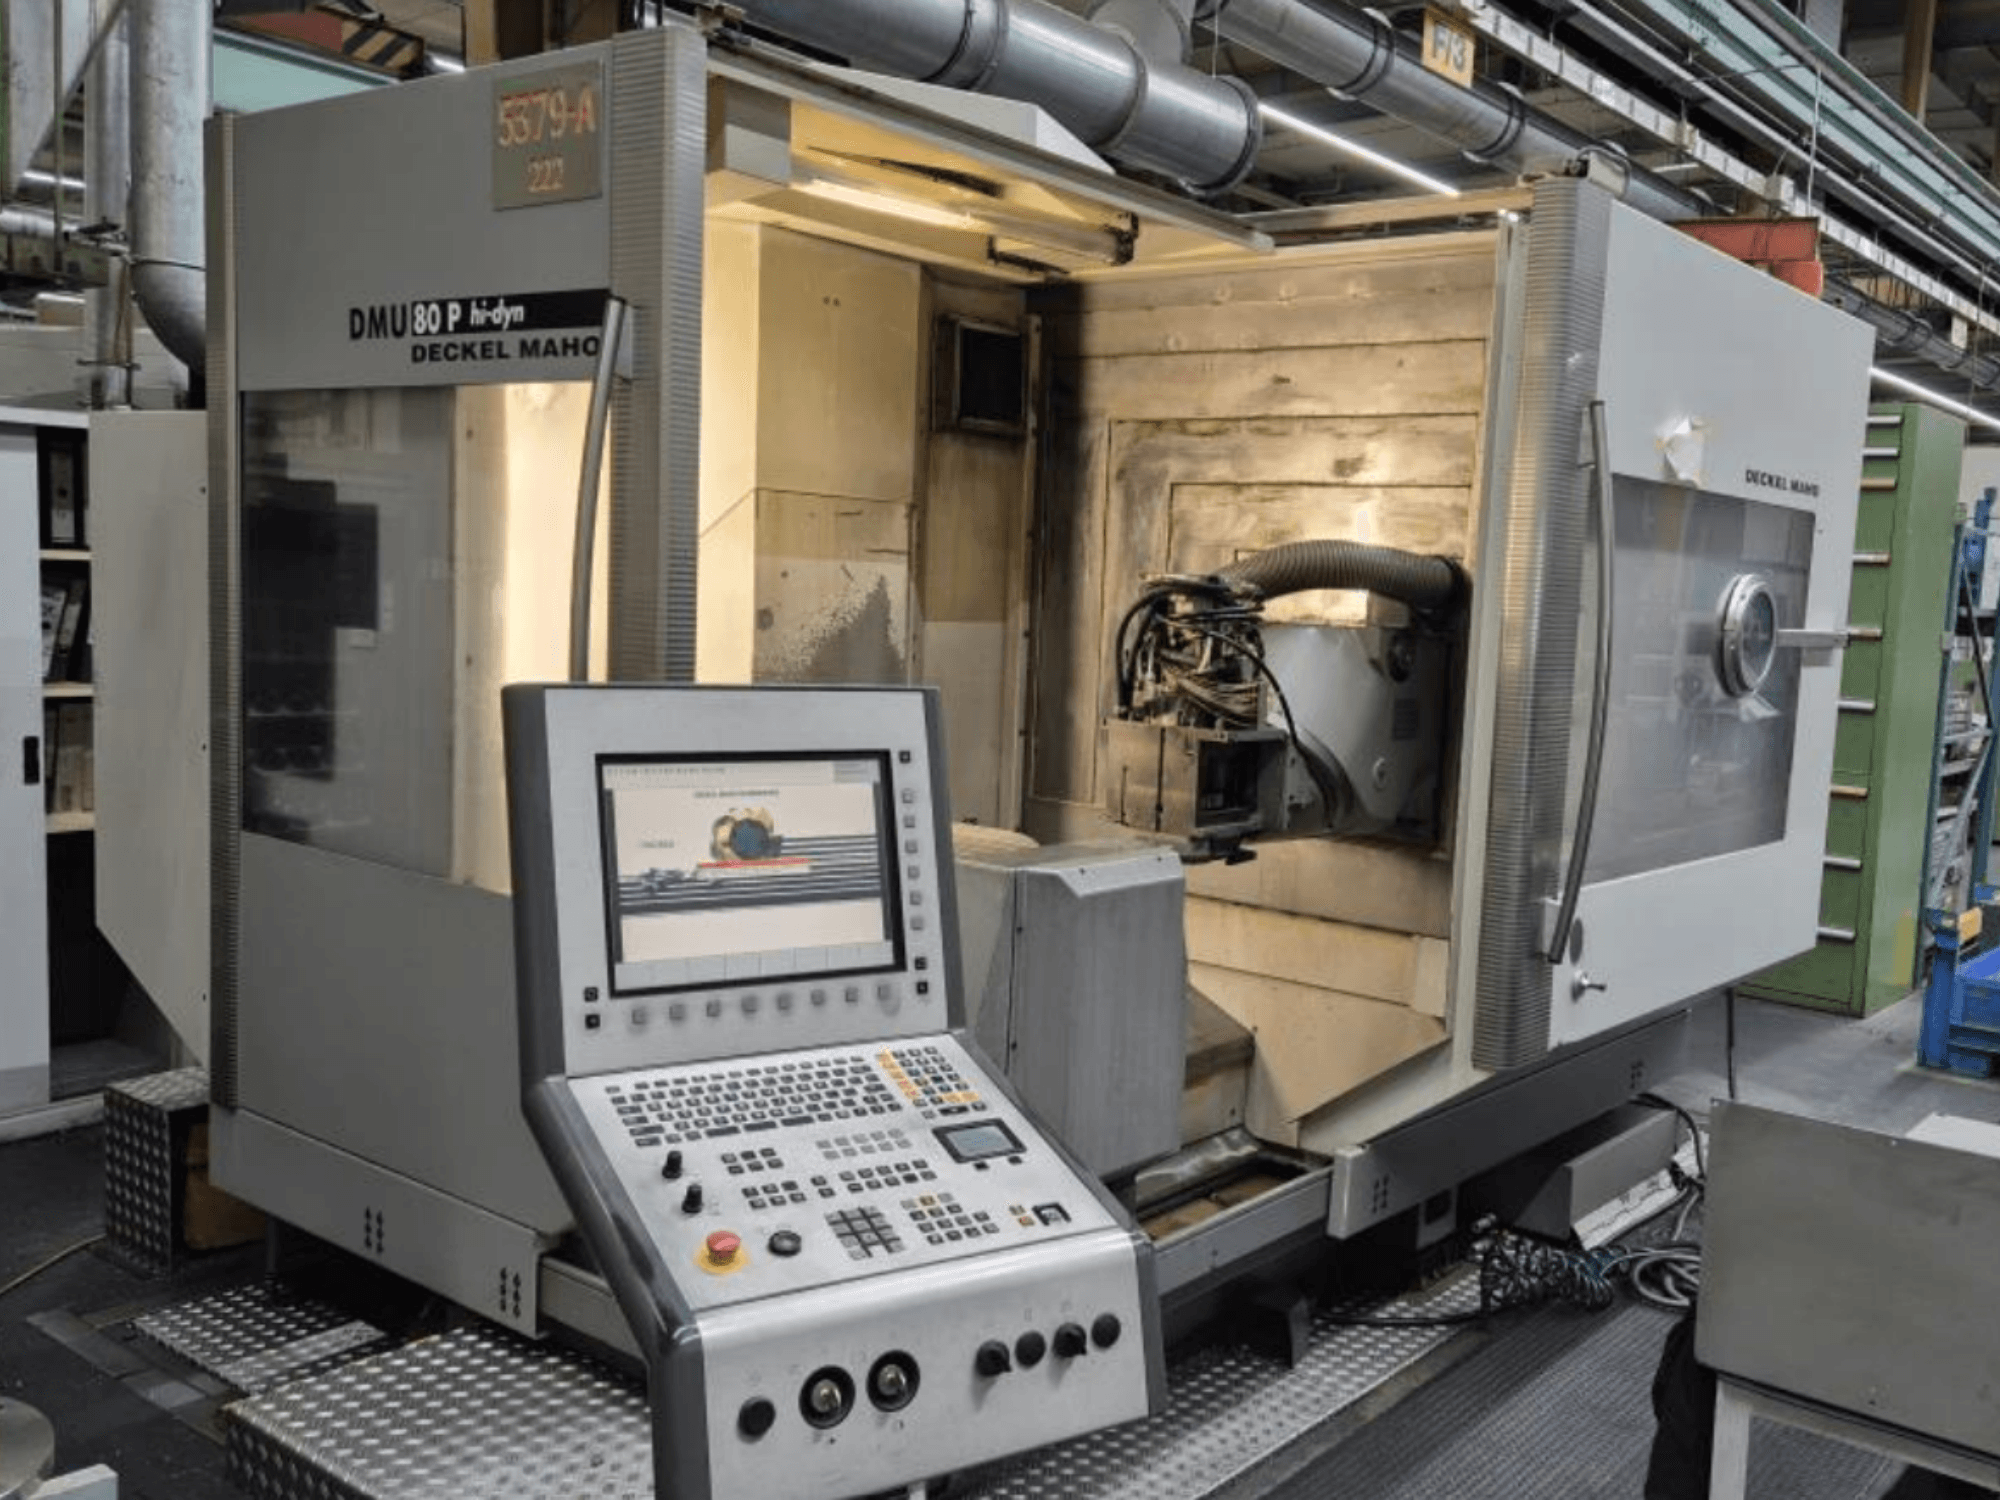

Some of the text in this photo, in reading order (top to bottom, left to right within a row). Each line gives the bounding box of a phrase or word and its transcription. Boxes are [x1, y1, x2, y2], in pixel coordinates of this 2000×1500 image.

[528, 157, 564, 193] 222
[349, 298, 525, 341] DMU 80 P hi-dyn
[411, 336, 601, 364] DECKEL MAHO
[1745, 468, 1788, 491] DECKEL
